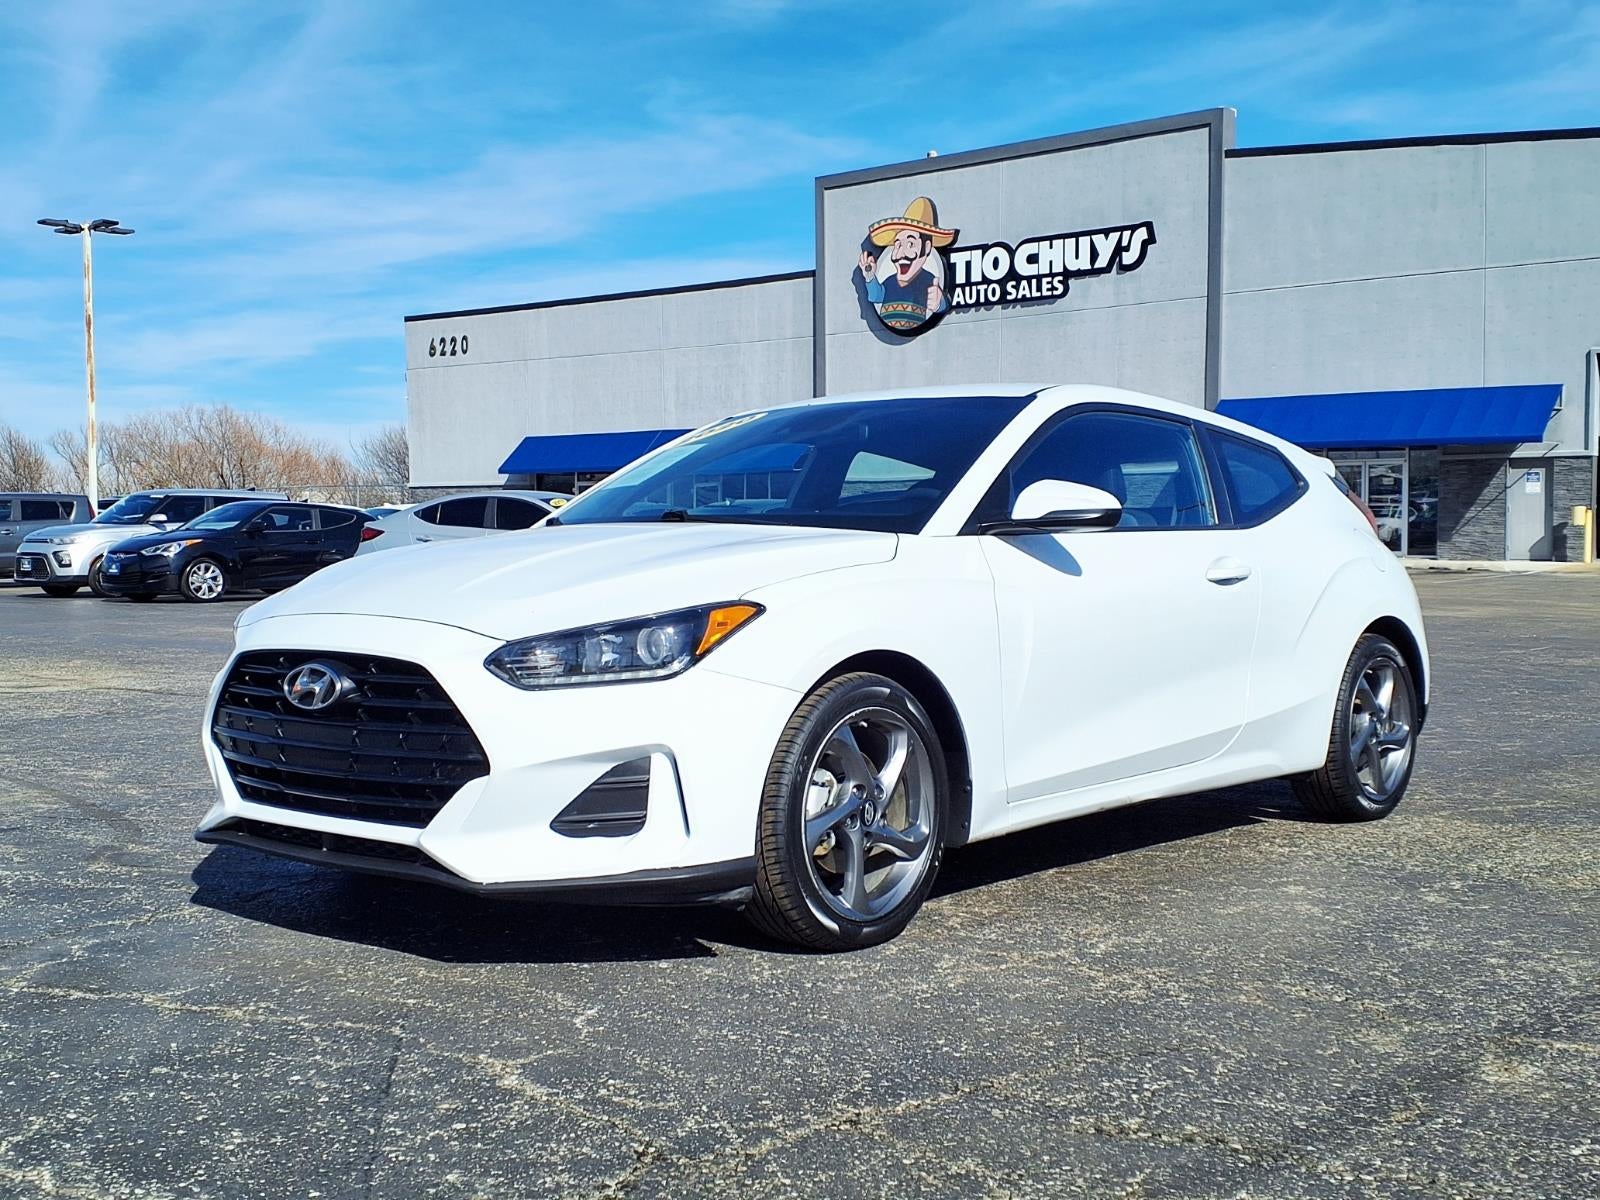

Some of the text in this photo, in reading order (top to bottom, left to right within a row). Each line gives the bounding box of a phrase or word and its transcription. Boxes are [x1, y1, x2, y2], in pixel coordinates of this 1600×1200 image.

[950, 227, 1149, 284] TIO CHUY'S
[952, 276, 1064, 306] AUTO SALES
[428, 335, 469, 357] 6220
